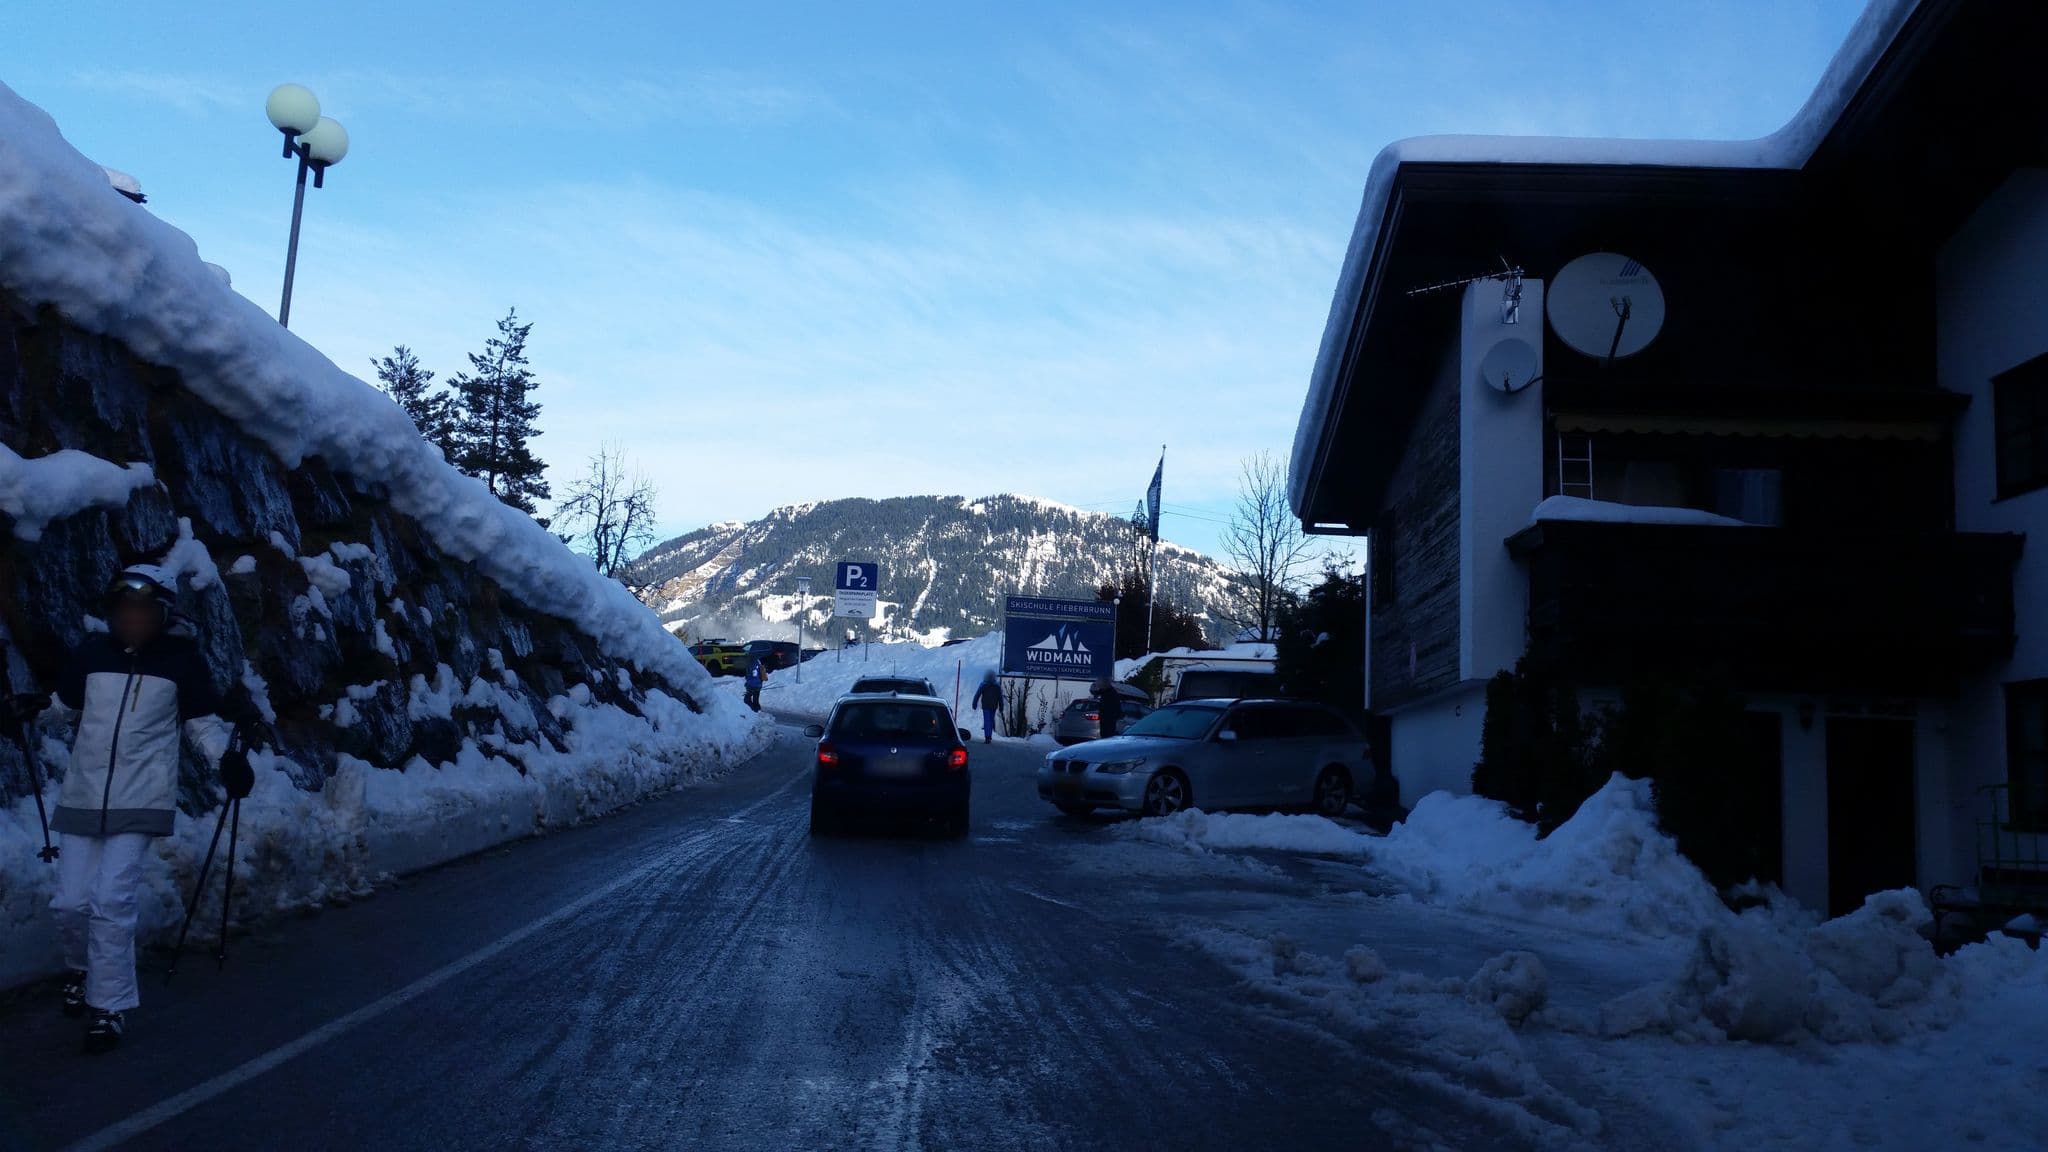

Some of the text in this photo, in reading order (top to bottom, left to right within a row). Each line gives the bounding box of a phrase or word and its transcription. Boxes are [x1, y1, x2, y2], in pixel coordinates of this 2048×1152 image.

[1010, 600, 1111, 614] SKISCHULE FIEBERBRUNN
[1026, 650, 1092, 664] WIDMANN
